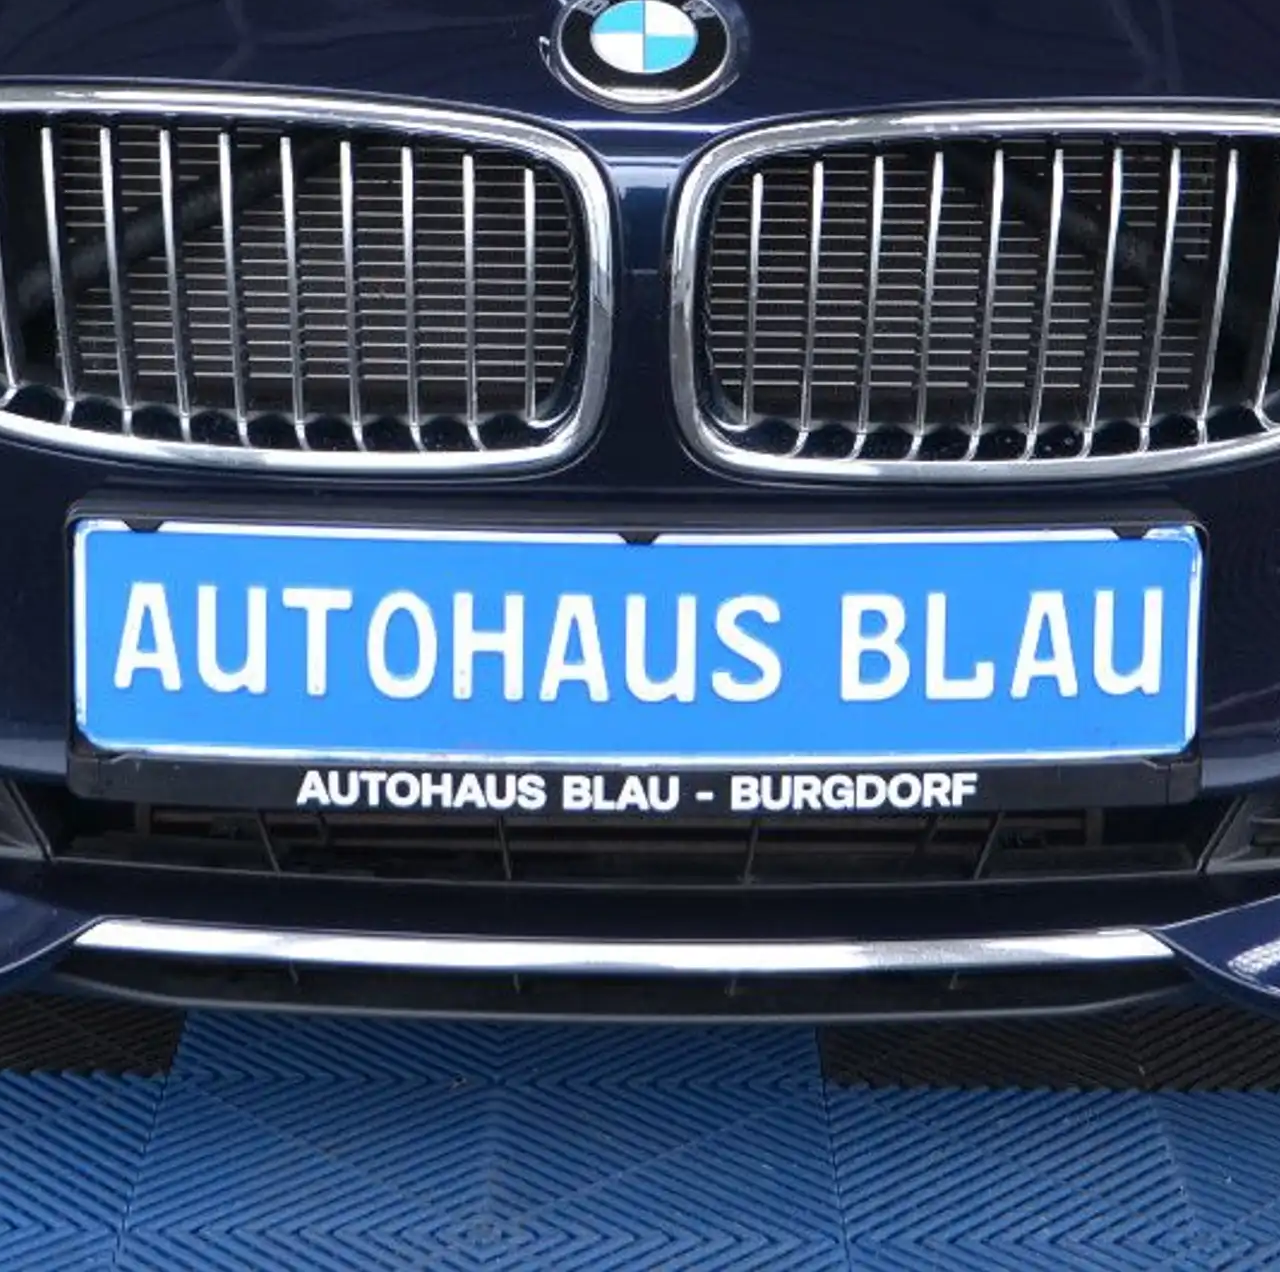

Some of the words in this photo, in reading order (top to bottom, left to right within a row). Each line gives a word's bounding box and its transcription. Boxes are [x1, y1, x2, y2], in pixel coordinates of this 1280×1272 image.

[114, 581, 782, 702] AUTOHAUS
[840, 587, 1163, 701] BLAU
[296, 769, 547, 810] AUTOHAUS
[562, 774, 680, 811] BLAU
[730, 772, 978, 810] BURGDORF
